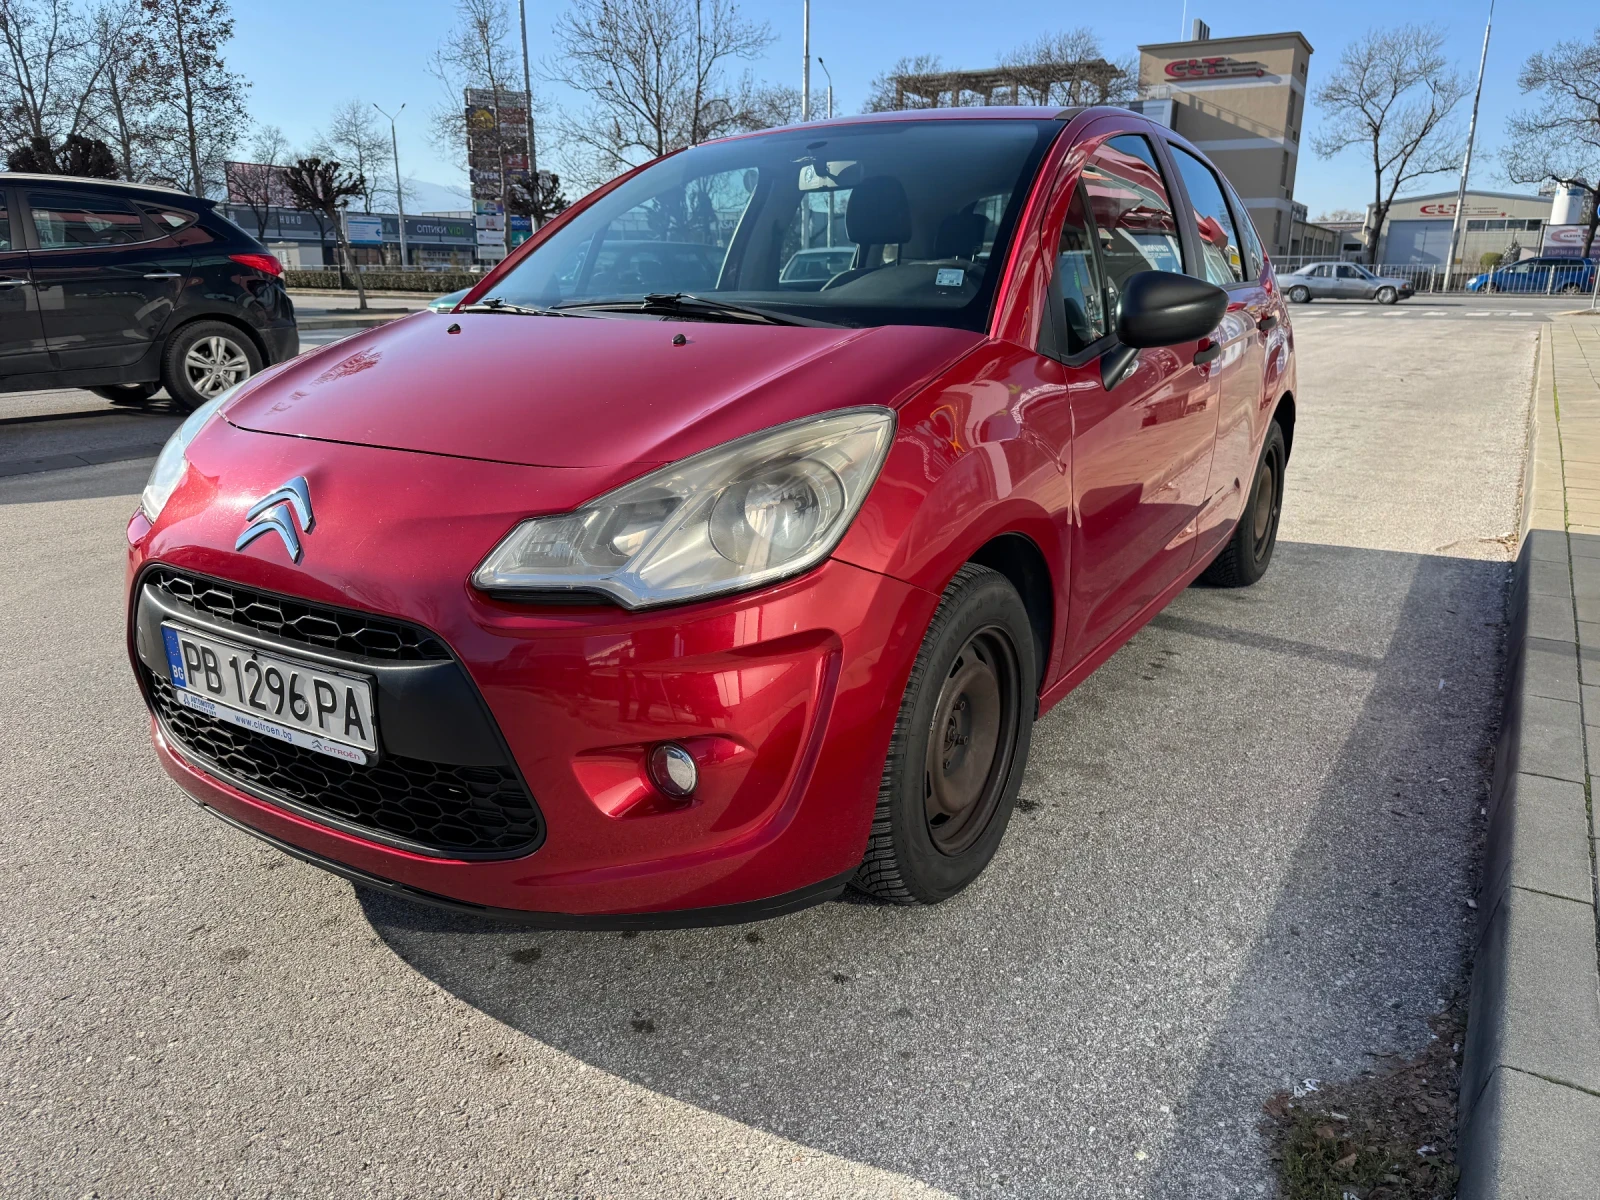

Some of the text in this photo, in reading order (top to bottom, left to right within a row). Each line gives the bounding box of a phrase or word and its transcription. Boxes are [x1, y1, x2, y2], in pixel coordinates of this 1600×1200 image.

[1164, 57, 1224, 77] CLT
[416, 224, 464, 235] ОПТИКИ VIDI
[172, 664, 184, 680] BG
[229, 654, 309, 722] 1296
[235, 714, 292, 741] www.citroen.bg
